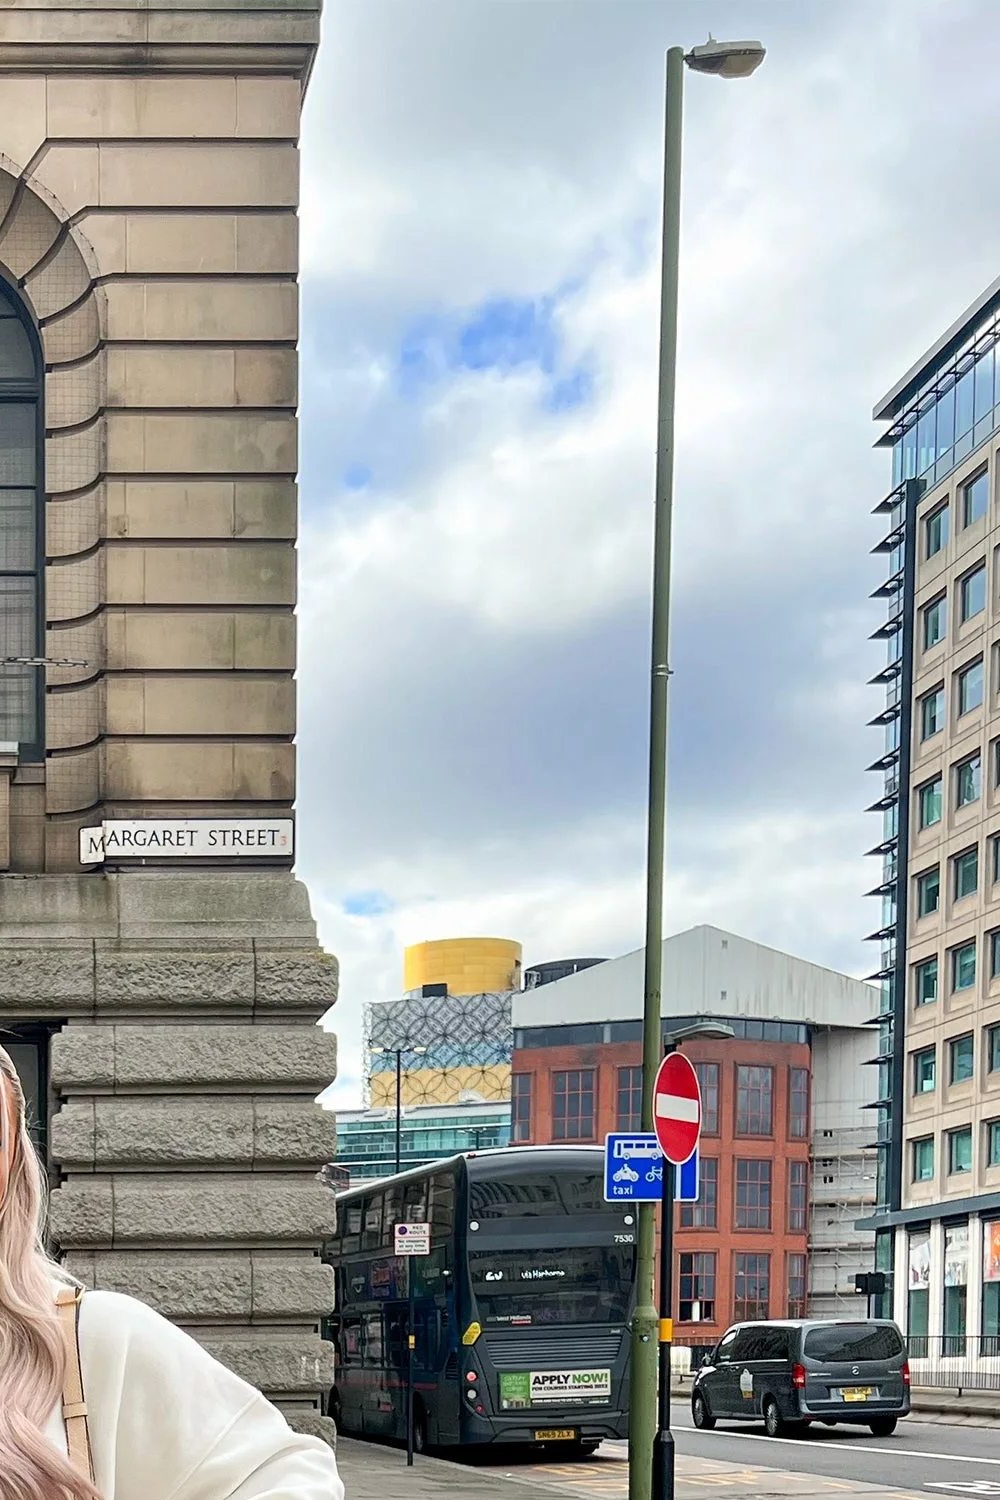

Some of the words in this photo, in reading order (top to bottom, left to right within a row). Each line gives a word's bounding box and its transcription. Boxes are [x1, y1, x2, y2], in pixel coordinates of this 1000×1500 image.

[88, 830, 198, 853] MARGARET
[208, 829, 280, 846] STREET
[613, 1185, 633, 1195] taxi
[613, 1234, 634, 1243] 7530
[532, 1374, 571, 1385] APPLY
[572, 1372, 609, 1384] NOW!
